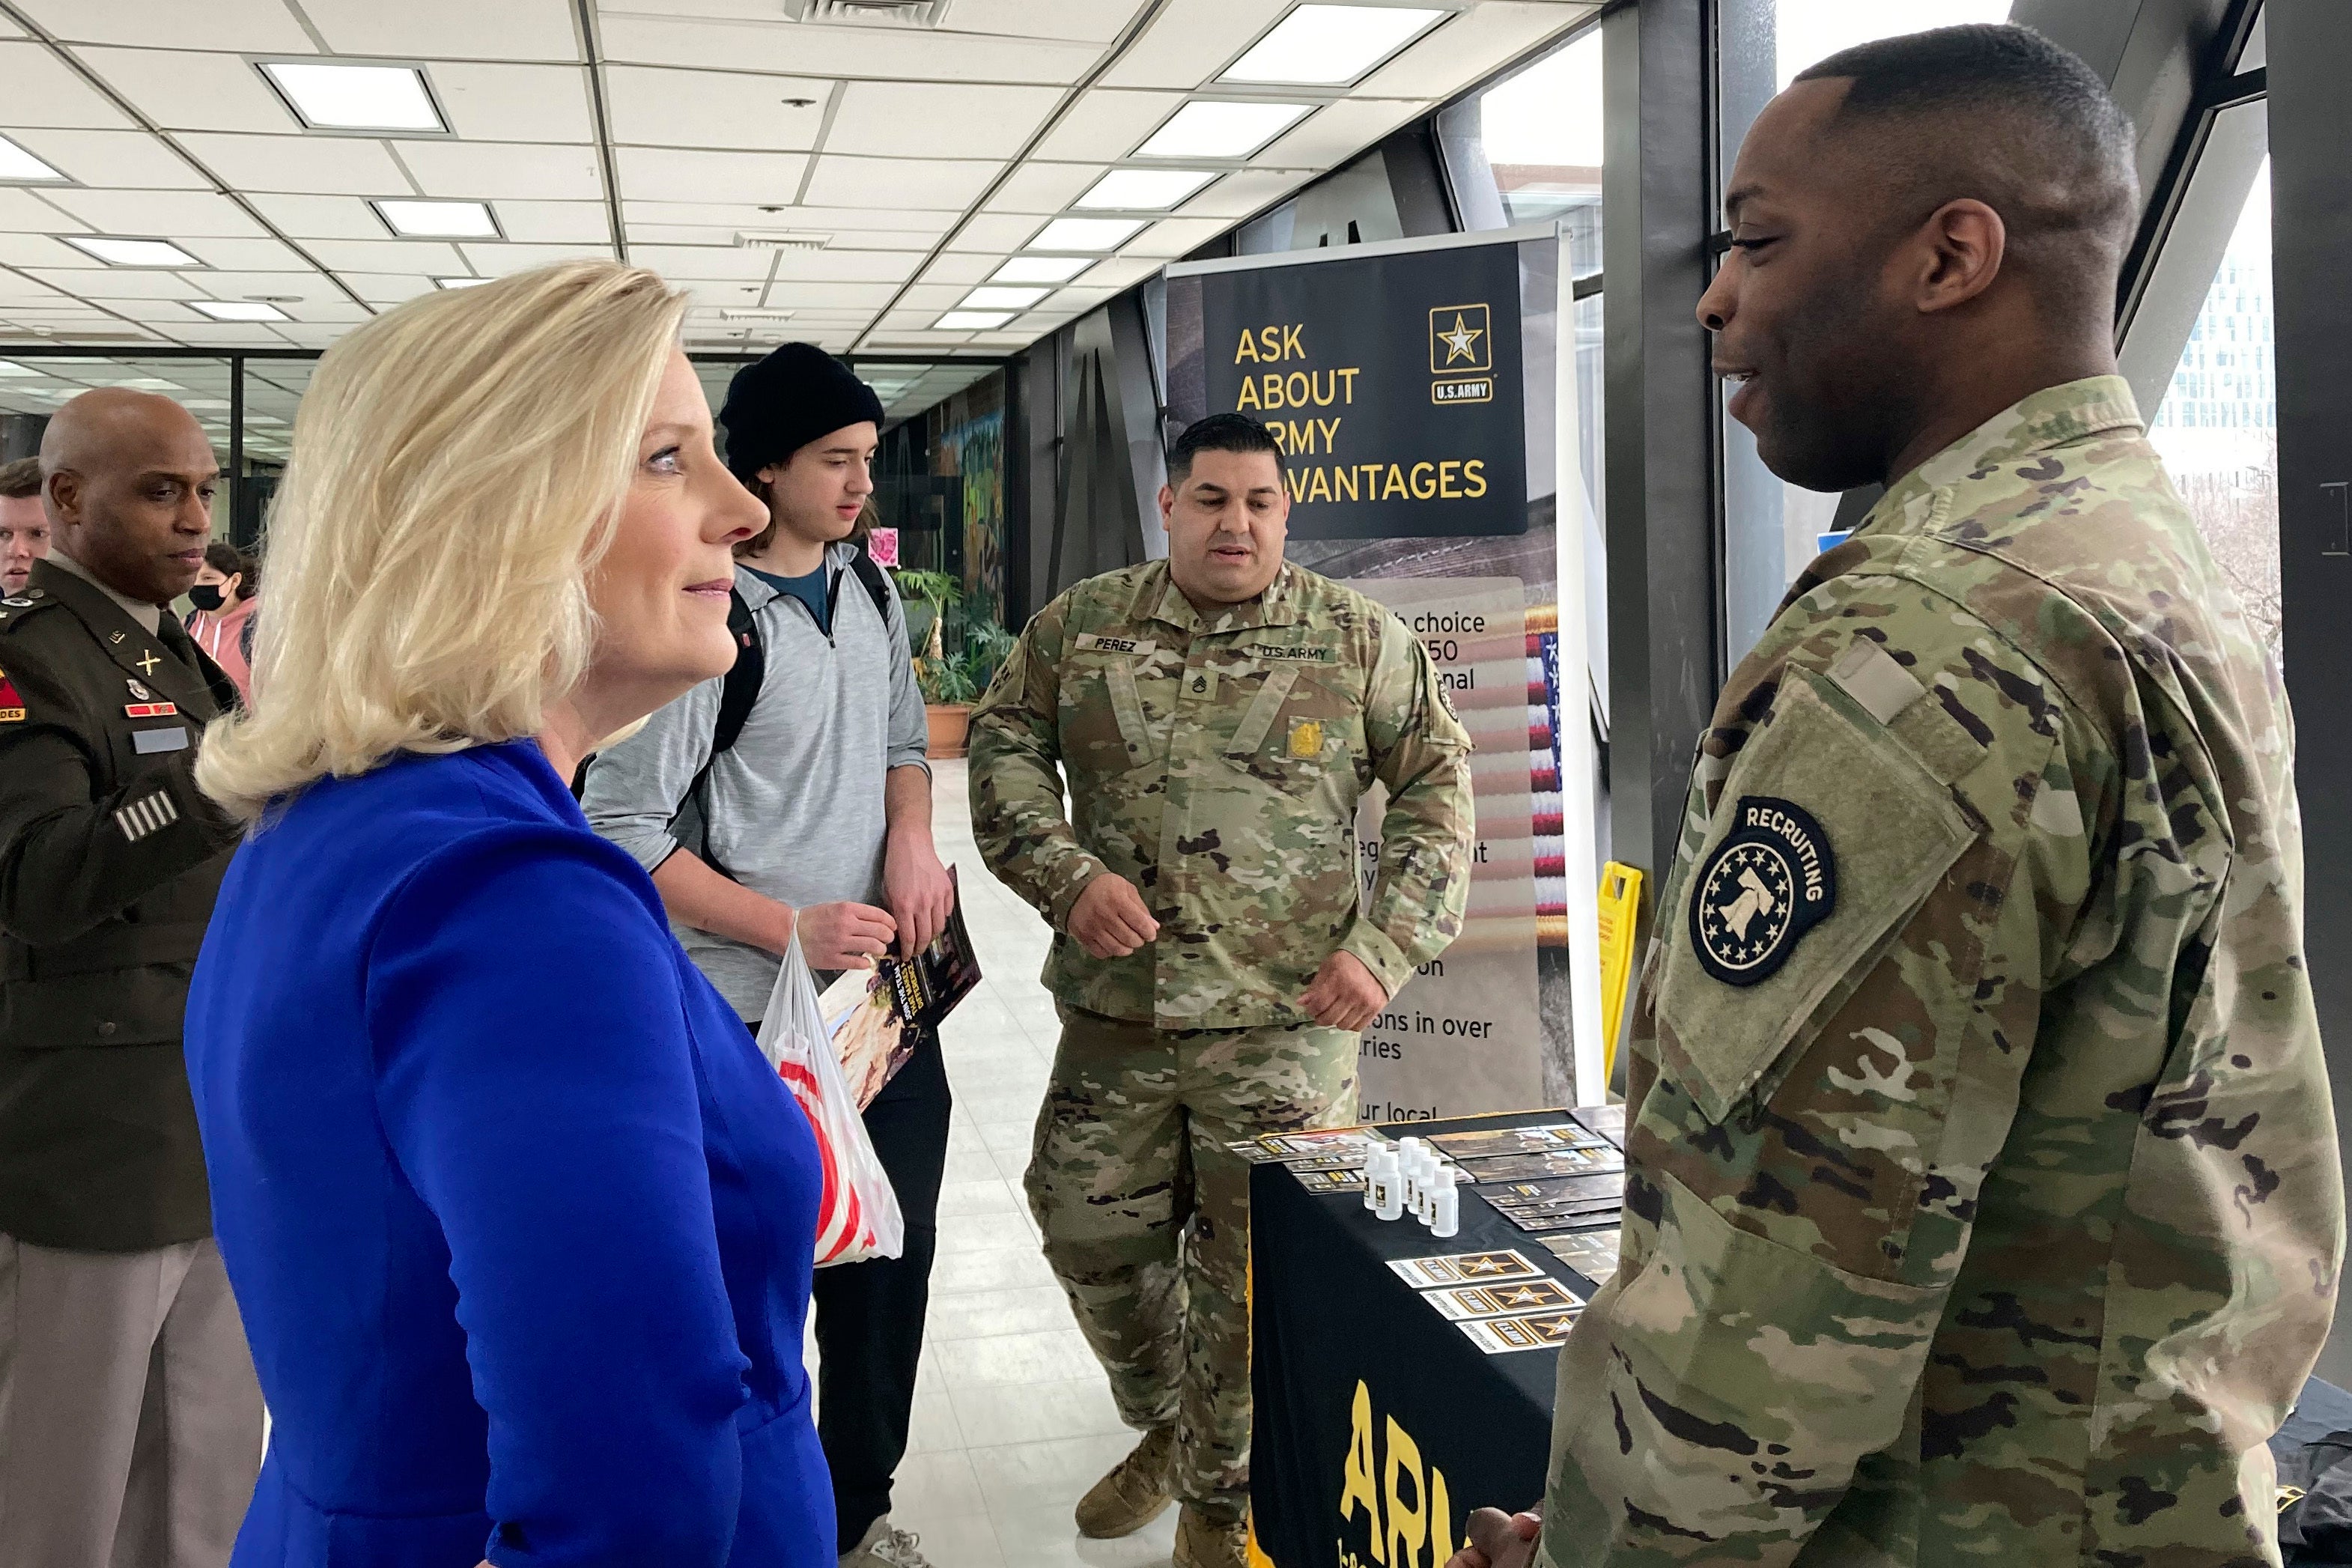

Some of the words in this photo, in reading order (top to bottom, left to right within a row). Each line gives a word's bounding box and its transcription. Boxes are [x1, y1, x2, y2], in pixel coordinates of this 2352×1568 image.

[1235, 324, 1306, 365] ASK
[1236, 368, 1360, 411] ABOUT
[1265, 417, 1342, 456] RMY
[1283, 459, 1488, 504] VANTAGES
[1414, 611, 1485, 633] choice
[1095, 637, 1137, 652] PEREZ
[1422, 639, 1457, 661] 50
[1442, 668, 1474, 690] nal
[0, 710, 21, 719] DES
[1745, 806, 1824, 902] RECRUITING
[1416, 1011, 1435, 1034] in
[1442, 1018, 1492, 1039] over
